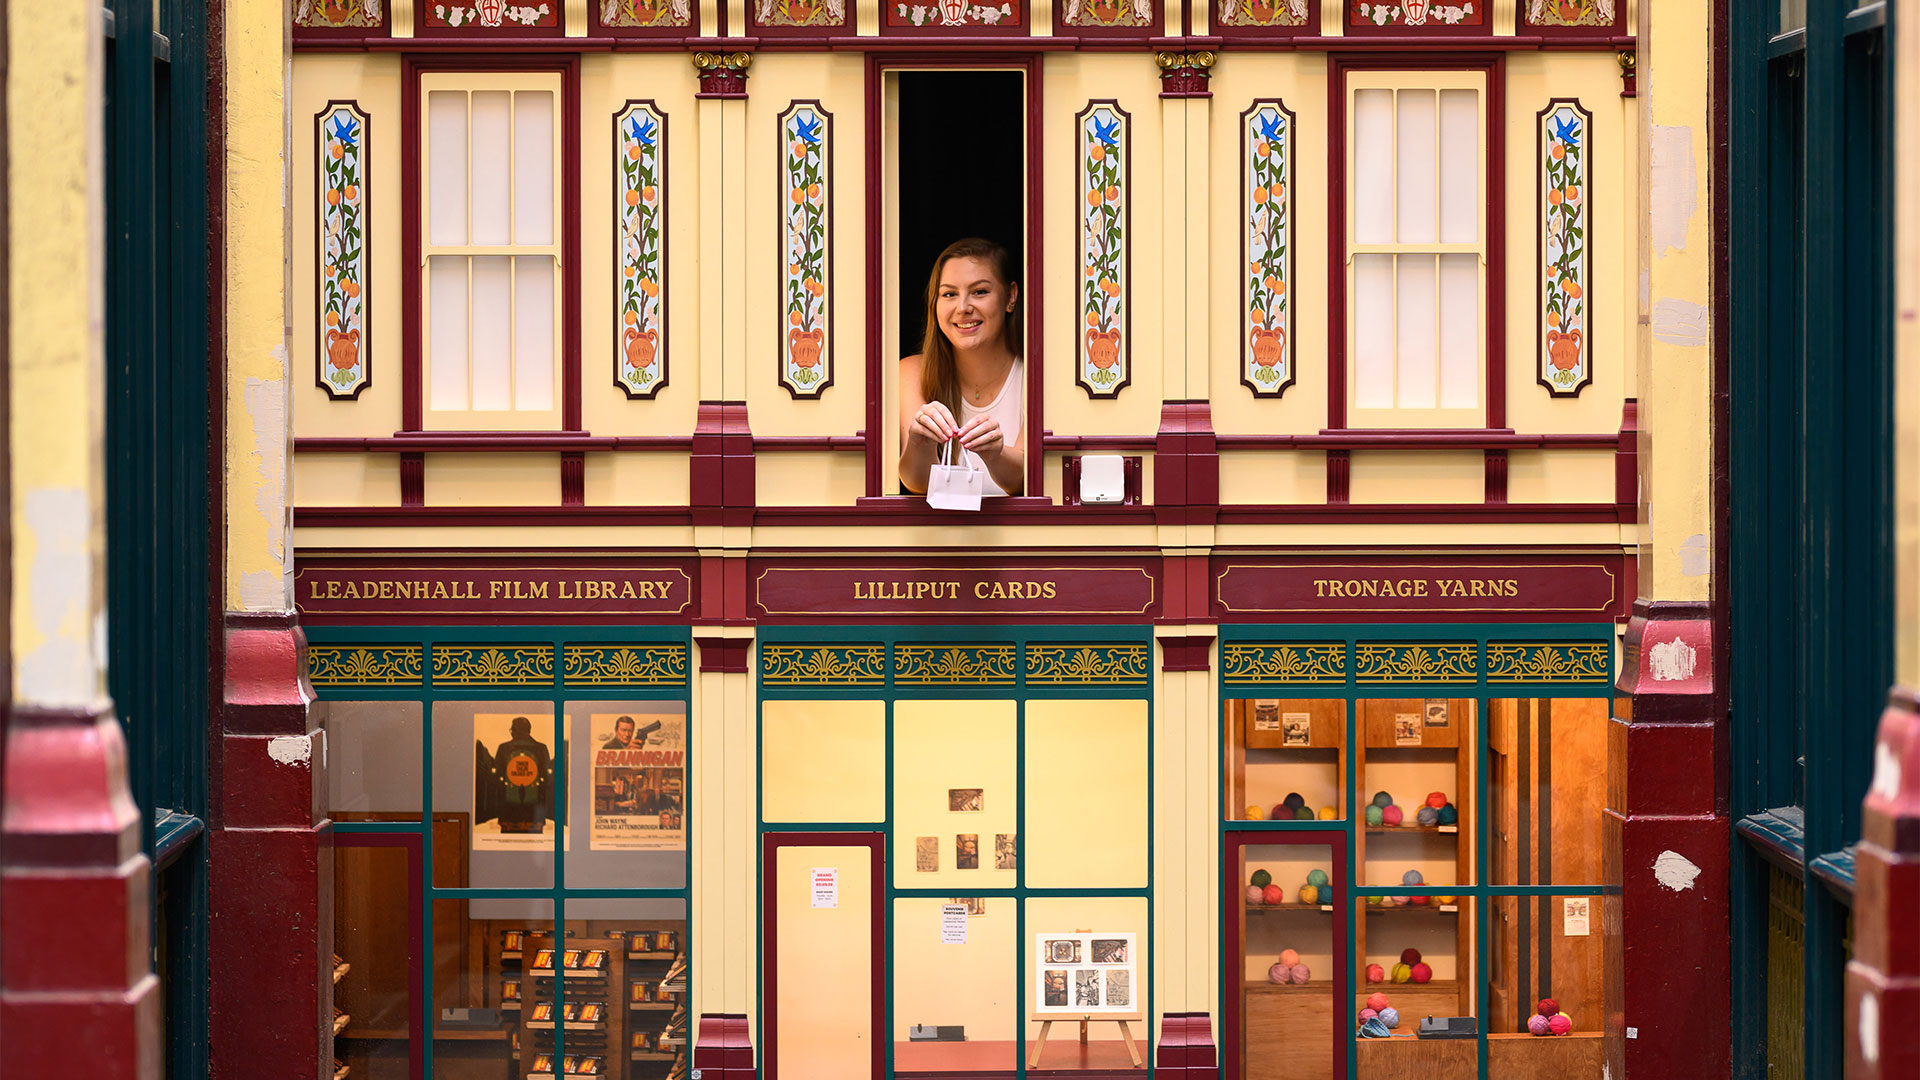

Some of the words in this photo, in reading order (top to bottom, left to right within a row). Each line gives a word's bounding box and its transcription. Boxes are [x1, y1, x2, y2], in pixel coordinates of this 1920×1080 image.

[310, 581, 481, 600] LEADENHALL
[489, 581, 549, 600] FILM
[558, 581, 674, 600] LIBRARY
[853, 581, 961, 600] LILLIPUT
[974, 581, 1057, 600] CARDS
[1313, 579, 1428, 597] TRONAGE
[1435, 579, 1519, 597] YARNS
[595, 750, 684, 767] BRANNIGAN
